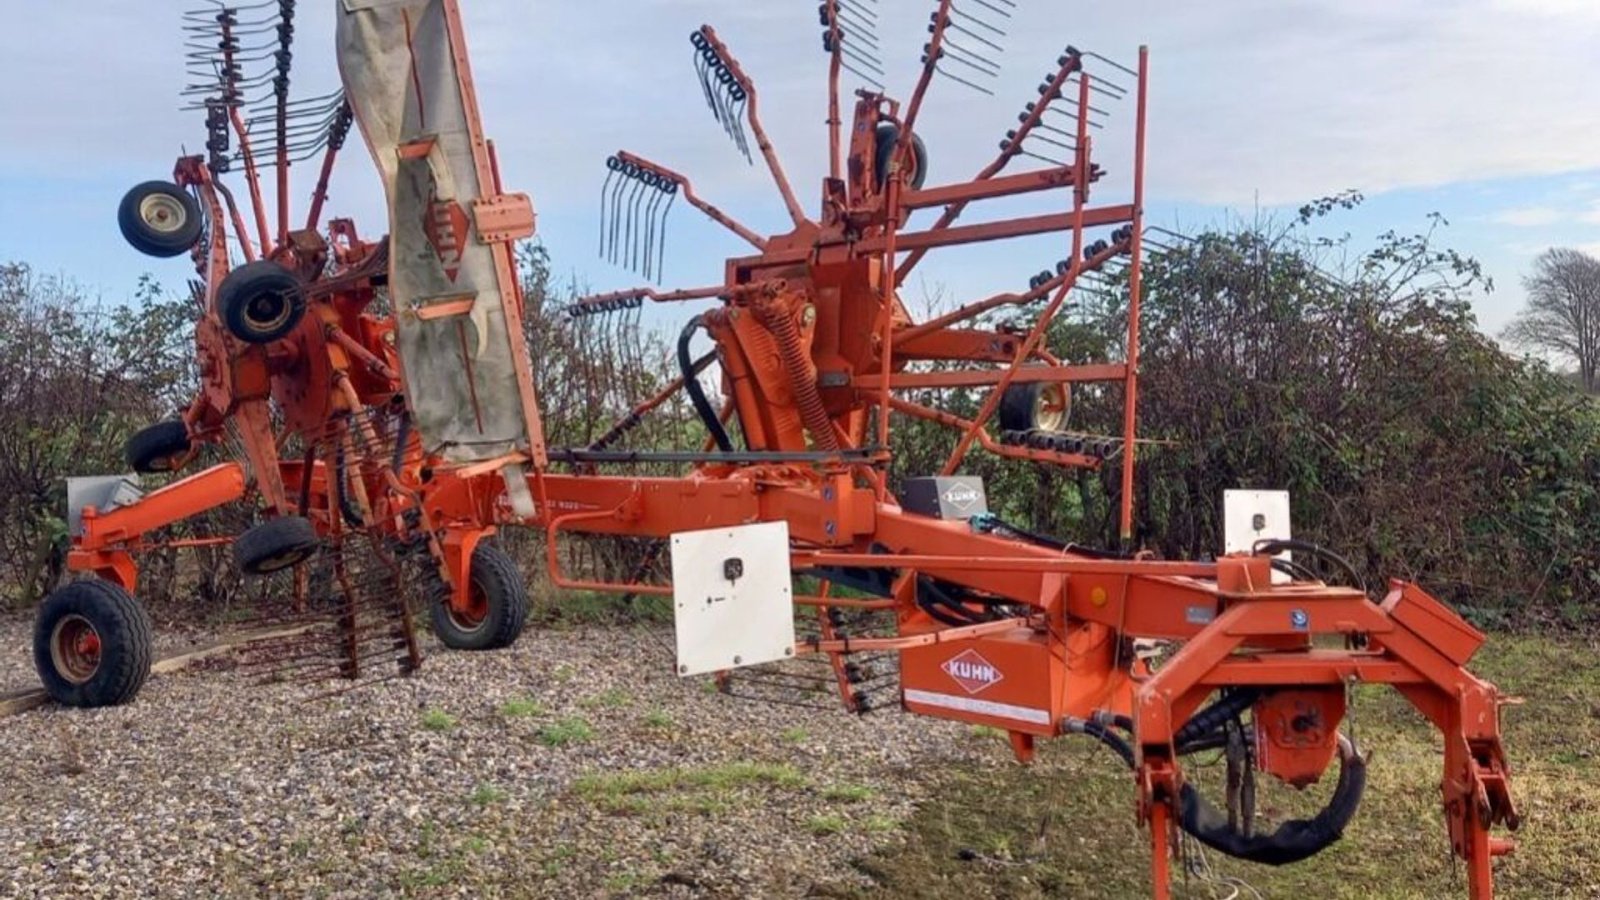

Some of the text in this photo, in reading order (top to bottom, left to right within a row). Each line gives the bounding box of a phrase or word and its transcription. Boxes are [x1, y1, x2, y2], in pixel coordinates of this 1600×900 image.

[433, 202, 461, 269] UHN
[947, 489, 977, 502] KUHN
[949, 660, 994, 683] KUHN
